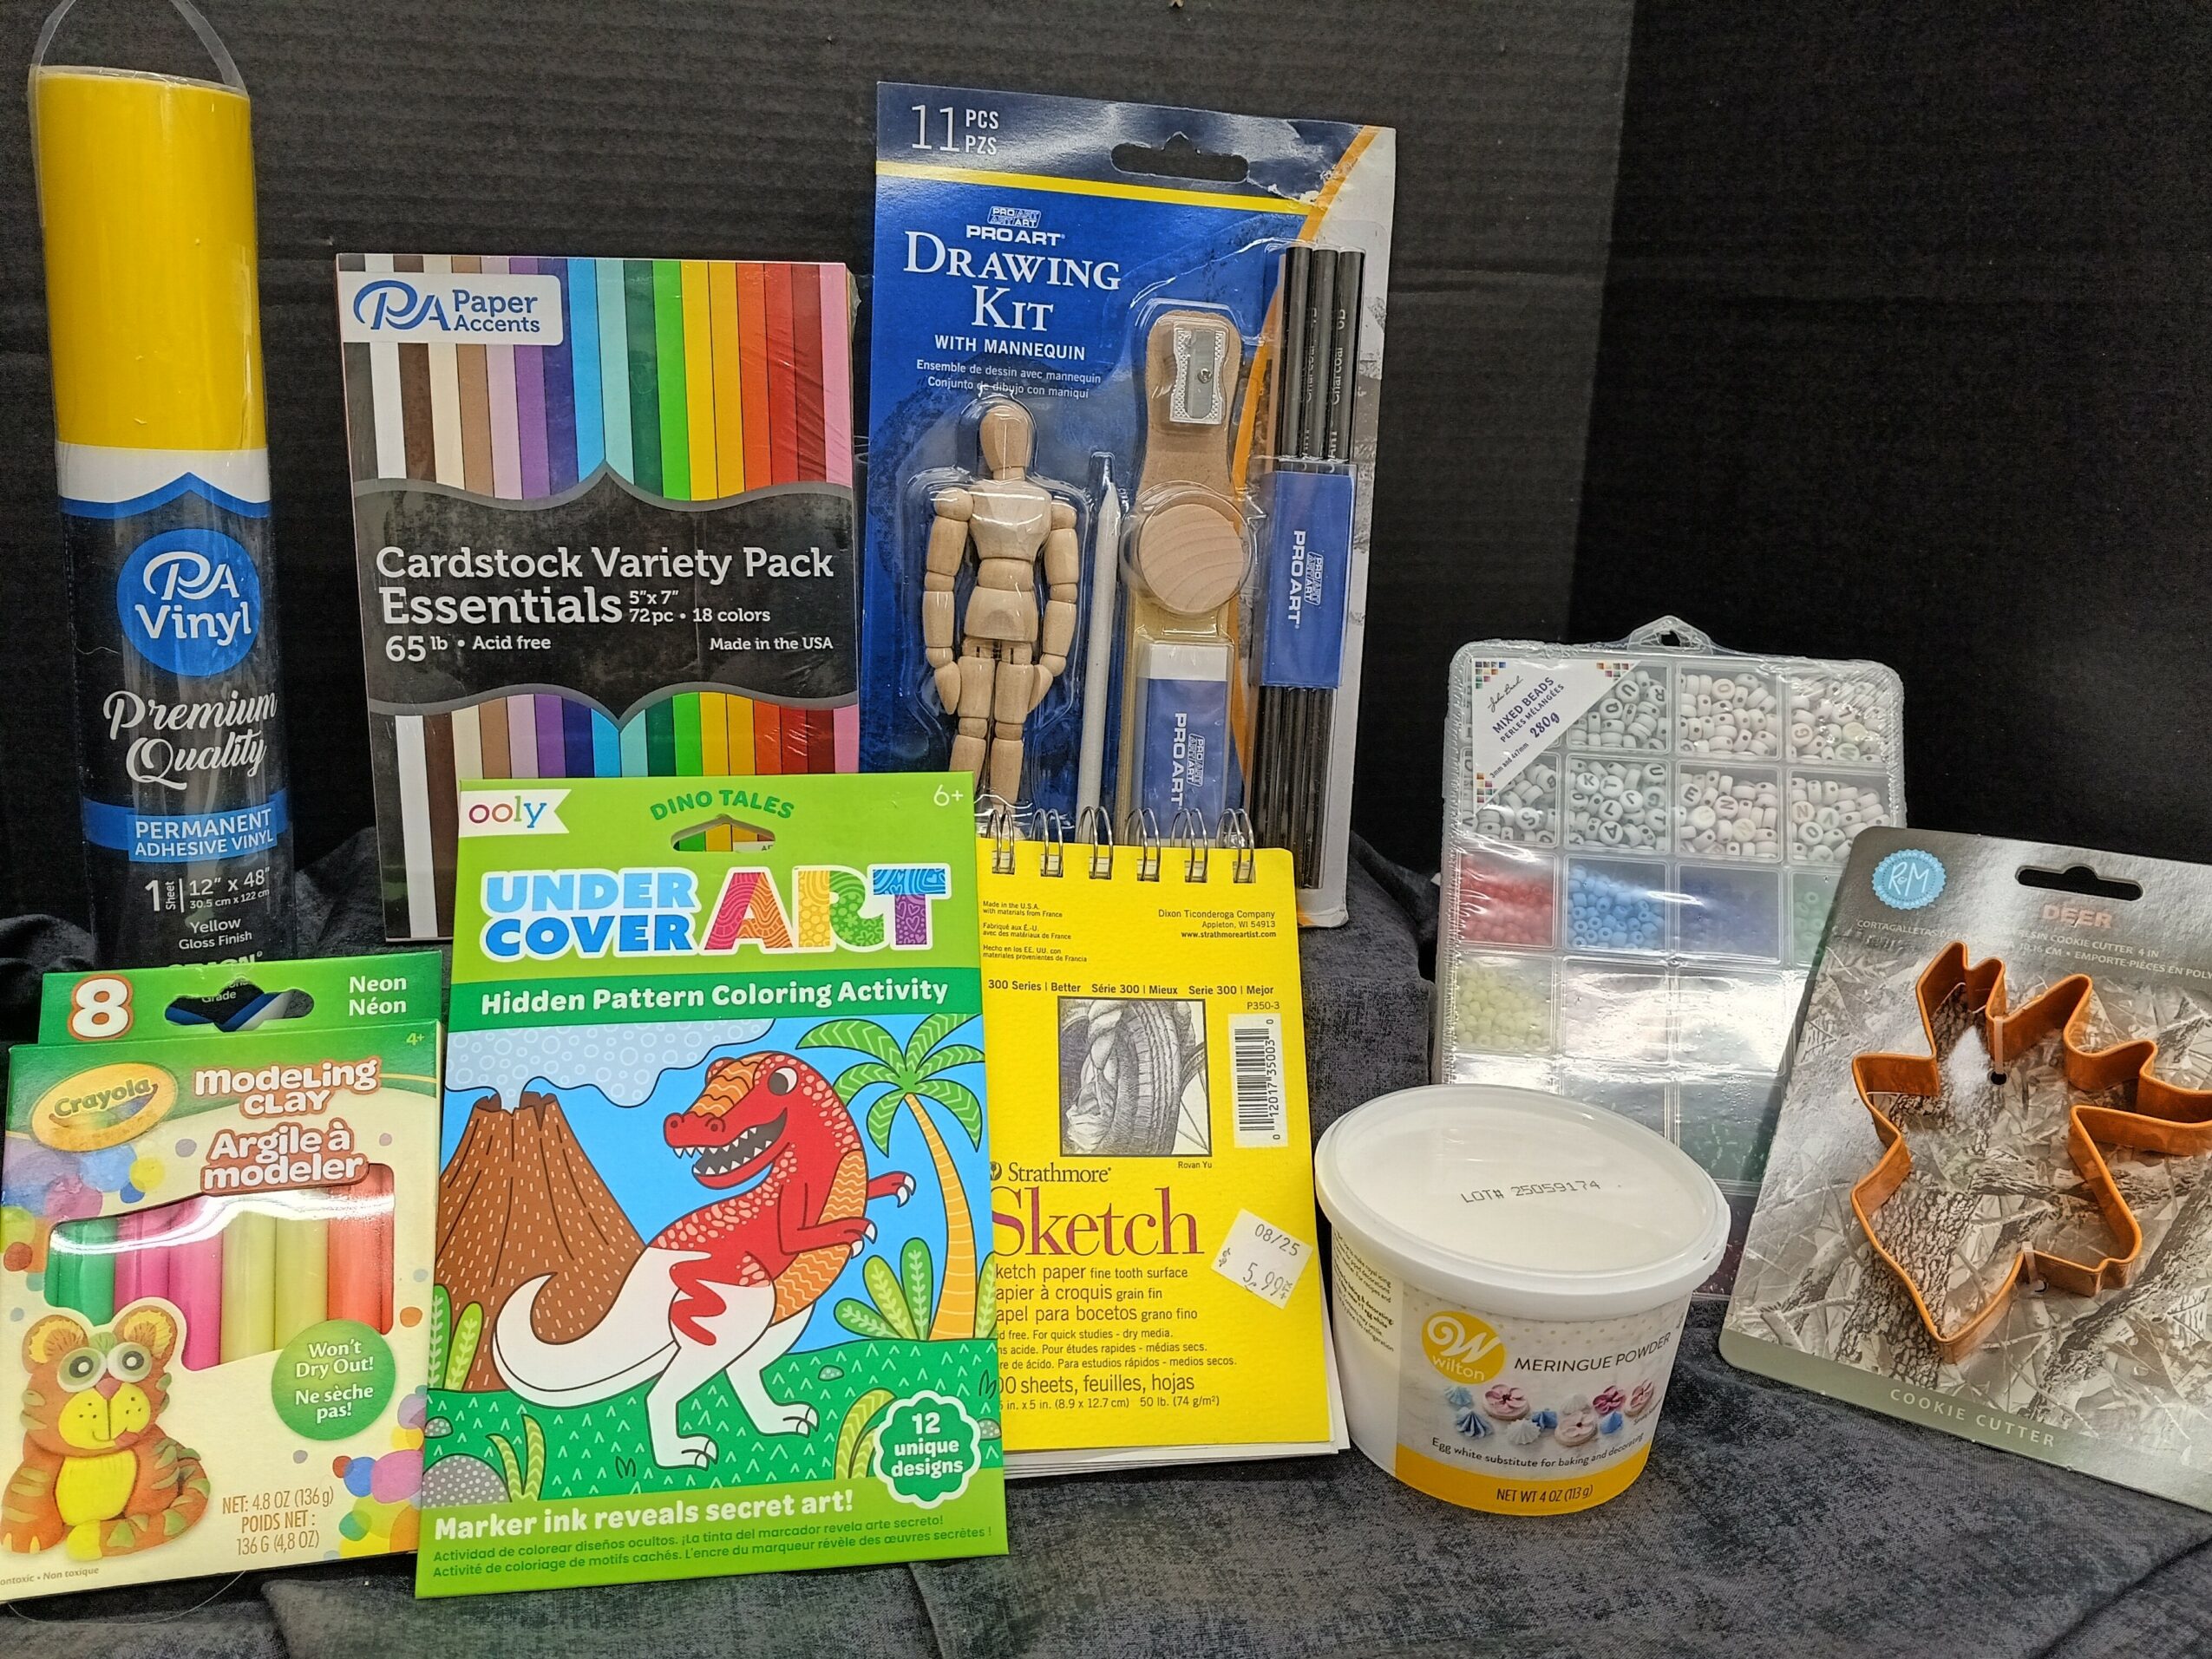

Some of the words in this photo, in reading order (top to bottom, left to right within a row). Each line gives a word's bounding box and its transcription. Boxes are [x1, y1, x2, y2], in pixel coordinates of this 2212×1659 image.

[911, 104, 960, 153] 11
[965, 108, 999, 130] PCS
[965, 135, 997, 155] PZS
[353, 280, 450, 331] PA
[453, 289, 539, 318] Paper
[454, 315, 540, 334] Accents
[935, 335, 976, 351] WITH
[985, 339, 1085, 361] MANNEQUIN
[917, 359, 966, 373] Ensemble
[970, 364, 982, 375] de
[985, 365, 1018, 377] dessin
[1021, 369, 1043, 379] avec
[1046, 370, 1101, 383] mannequin
[928, 376, 973, 390] Conjunto
[1027, 385, 1045, 395] con
[144, 552, 239, 601] PA
[376, 545, 583, 578] Cardstock
[591, 547, 732, 585] Variety
[743, 546, 834, 578] Pack
[378, 585, 623, 625] Essentials
[629, 608, 673, 626] 72pc
[692, 607, 713, 623] 18
[717, 607, 770, 623] colors
[135, 603, 252, 646] Vinyl
[385, 634, 427, 662] 65
[430, 635, 448, 651] lb
[473, 635, 512, 650] Acid
[515, 635, 552, 650] free
[710, 636, 752, 651] Made
[755, 636, 771, 651] in
[775, 637, 797, 650] the
[802, 637, 833, 650] USA
[103, 690, 278, 740] Premium
[1493, 705, 1523, 734] MIXED
[1522, 677, 1554, 706] BEADS
[1501, 718, 1526, 742] PERLES
[1525, 683, 1564, 721] MÉLANGÉES
[1530, 713, 1560, 738] 280g
[126, 730, 266, 790] Quality
[651, 791, 712, 820] DINO
[719, 790, 794, 819] TALES
[934, 784, 963, 807] 6+
[135, 808, 272, 839] PERMANENT
[468, 795, 546, 830] ooly
[135, 839, 227, 857] ADHESIVE
[232, 829, 274, 851] VINYL
[145, 879, 160, 911] 1
[166, 879, 177, 911] Sheet
[190, 898, 213, 909] 30.5
[215, 897, 231, 907] cm
[241, 892, 256, 903] 122
[483, 872, 696, 911] UNDER
[704, 869, 946, 951] ART
[1184, 910, 1234, 919] Ticonderoga
[1237, 911, 1275, 919] Company
[2041, 905, 2112, 929] DEER
[190, 918, 241, 934] Yellow
[484, 915, 693, 957] COVER
[1857, 920, 1938, 936] CORTAGALLETAS
[179, 936, 215, 950] Gloss
[219, 931, 252, 946] Finish
[2050, 934, 2091, 946] COOKIE
[2092, 941, 2133, 954] CUTTER
[349, 976, 407, 993] Neon
[481, 986, 586, 1016] Hidden
[592, 982, 704, 1010] Pattern
[710, 978, 833, 1009] Coloring
[836, 979, 948, 1005] Activity
[989, 980, 1008, 990] 300
[1011, 981, 1041, 991] Series
[1051, 982, 1081, 992] Better
[72, 977, 128, 1037] 8
[349, 996, 407, 1015] Néon
[406, 1033, 424, 1045] 4+
[54, 1077, 152, 1118] Crayola
[211, 1126, 323, 1165] Argile
[328, 1120, 350, 1150] à
[205, 1155, 364, 1189] modeler
[1009, 1161, 1109, 1182] Strathmore
[1462, 1189, 1504, 1203] LOT#
[1511, 1179, 1600, 1198] 25059174
[991, 1185, 1204, 1257] Sketch
[1255, 1224, 1299, 1256] 08/25
[1044, 1266, 1086, 1283] paper
[1090, 1268, 1110, 1278] fine
[1115, 1268, 1142, 1277] tooth
[1148, 1267, 1188, 1277] surface
[1056, 1284, 1112, 1302] croquis
[1077, 1305, 1137, 1321] bocetos
[1009, 1330, 1030, 1340] free.
[1033, 1329, 1048, 1339] For
[1050, 1329, 1076, 1341] quick
[1079, 1329, 1113, 1339] studies
[1122, 1329, 1137, 1341] dry
[1141, 1329, 1173, 1338] media.
[308, 1339, 363, 1358] Won't
[1514, 1356, 1613, 1372] MERINGUE
[1616, 1332, 1671, 1366] POWDER
[295, 1362, 329, 1379] Dry
[333, 1355, 374, 1372] Out!
[1432, 1355, 1485, 1381] wilton
[295, 1388, 319, 1405] Ne
[324, 1386, 374, 1402] sèche
[1021, 1376, 1078, 1394] sheets,
[1084, 1374, 1146, 1394] feuilles,
[1152, 1374, 1194, 1394] hojas
[317, 1402, 352, 1423] pas!
[911, 1412, 941, 1434] 12
[1889, 1388, 1966, 1421] COOKIE
[1975, 1414, 2056, 1448] CUTTER
[893, 1438, 960, 1459] unique
[1432, 1437, 1450, 1454] Egg
[1454, 1447, 1482, 1460] white
[1485, 1453, 1538, 1467] substitute
[1541, 1458, 1555, 1466] for
[1559, 1455, 1589, 1467] baking
[1592, 1450, 1607, 1462] and
[891, 1456, 964, 1478] designs
[222, 1496, 249, 1514] NET:
[252, 1492, 272, 1512] 4.8
[274, 1491, 291, 1509] OZ
[295, 1486, 320, 1507] (136
[1496, 1488, 1517, 1502] NET
[1520, 1490, 1537, 1502] WT
[1549, 1488, 1563, 1502] OZ
[241, 1514, 280, 1534] POIDS
[284, 1511, 308, 1531] NET
[435, 1513, 537, 1540] Marker
[545, 1508, 587, 1532] ink
[595, 1500, 699, 1529] reveals
[705, 1494, 795, 1521] secret
[802, 1489, 853, 1514] art!
[434, 1547, 495, 1561] Actividad
[498, 1545, 515, 1558] de
[519, 1544, 572, 1555] colorear
[575, 1539, 625, 1552] diseños
[628, 1535, 678, 1549] ocultos.
